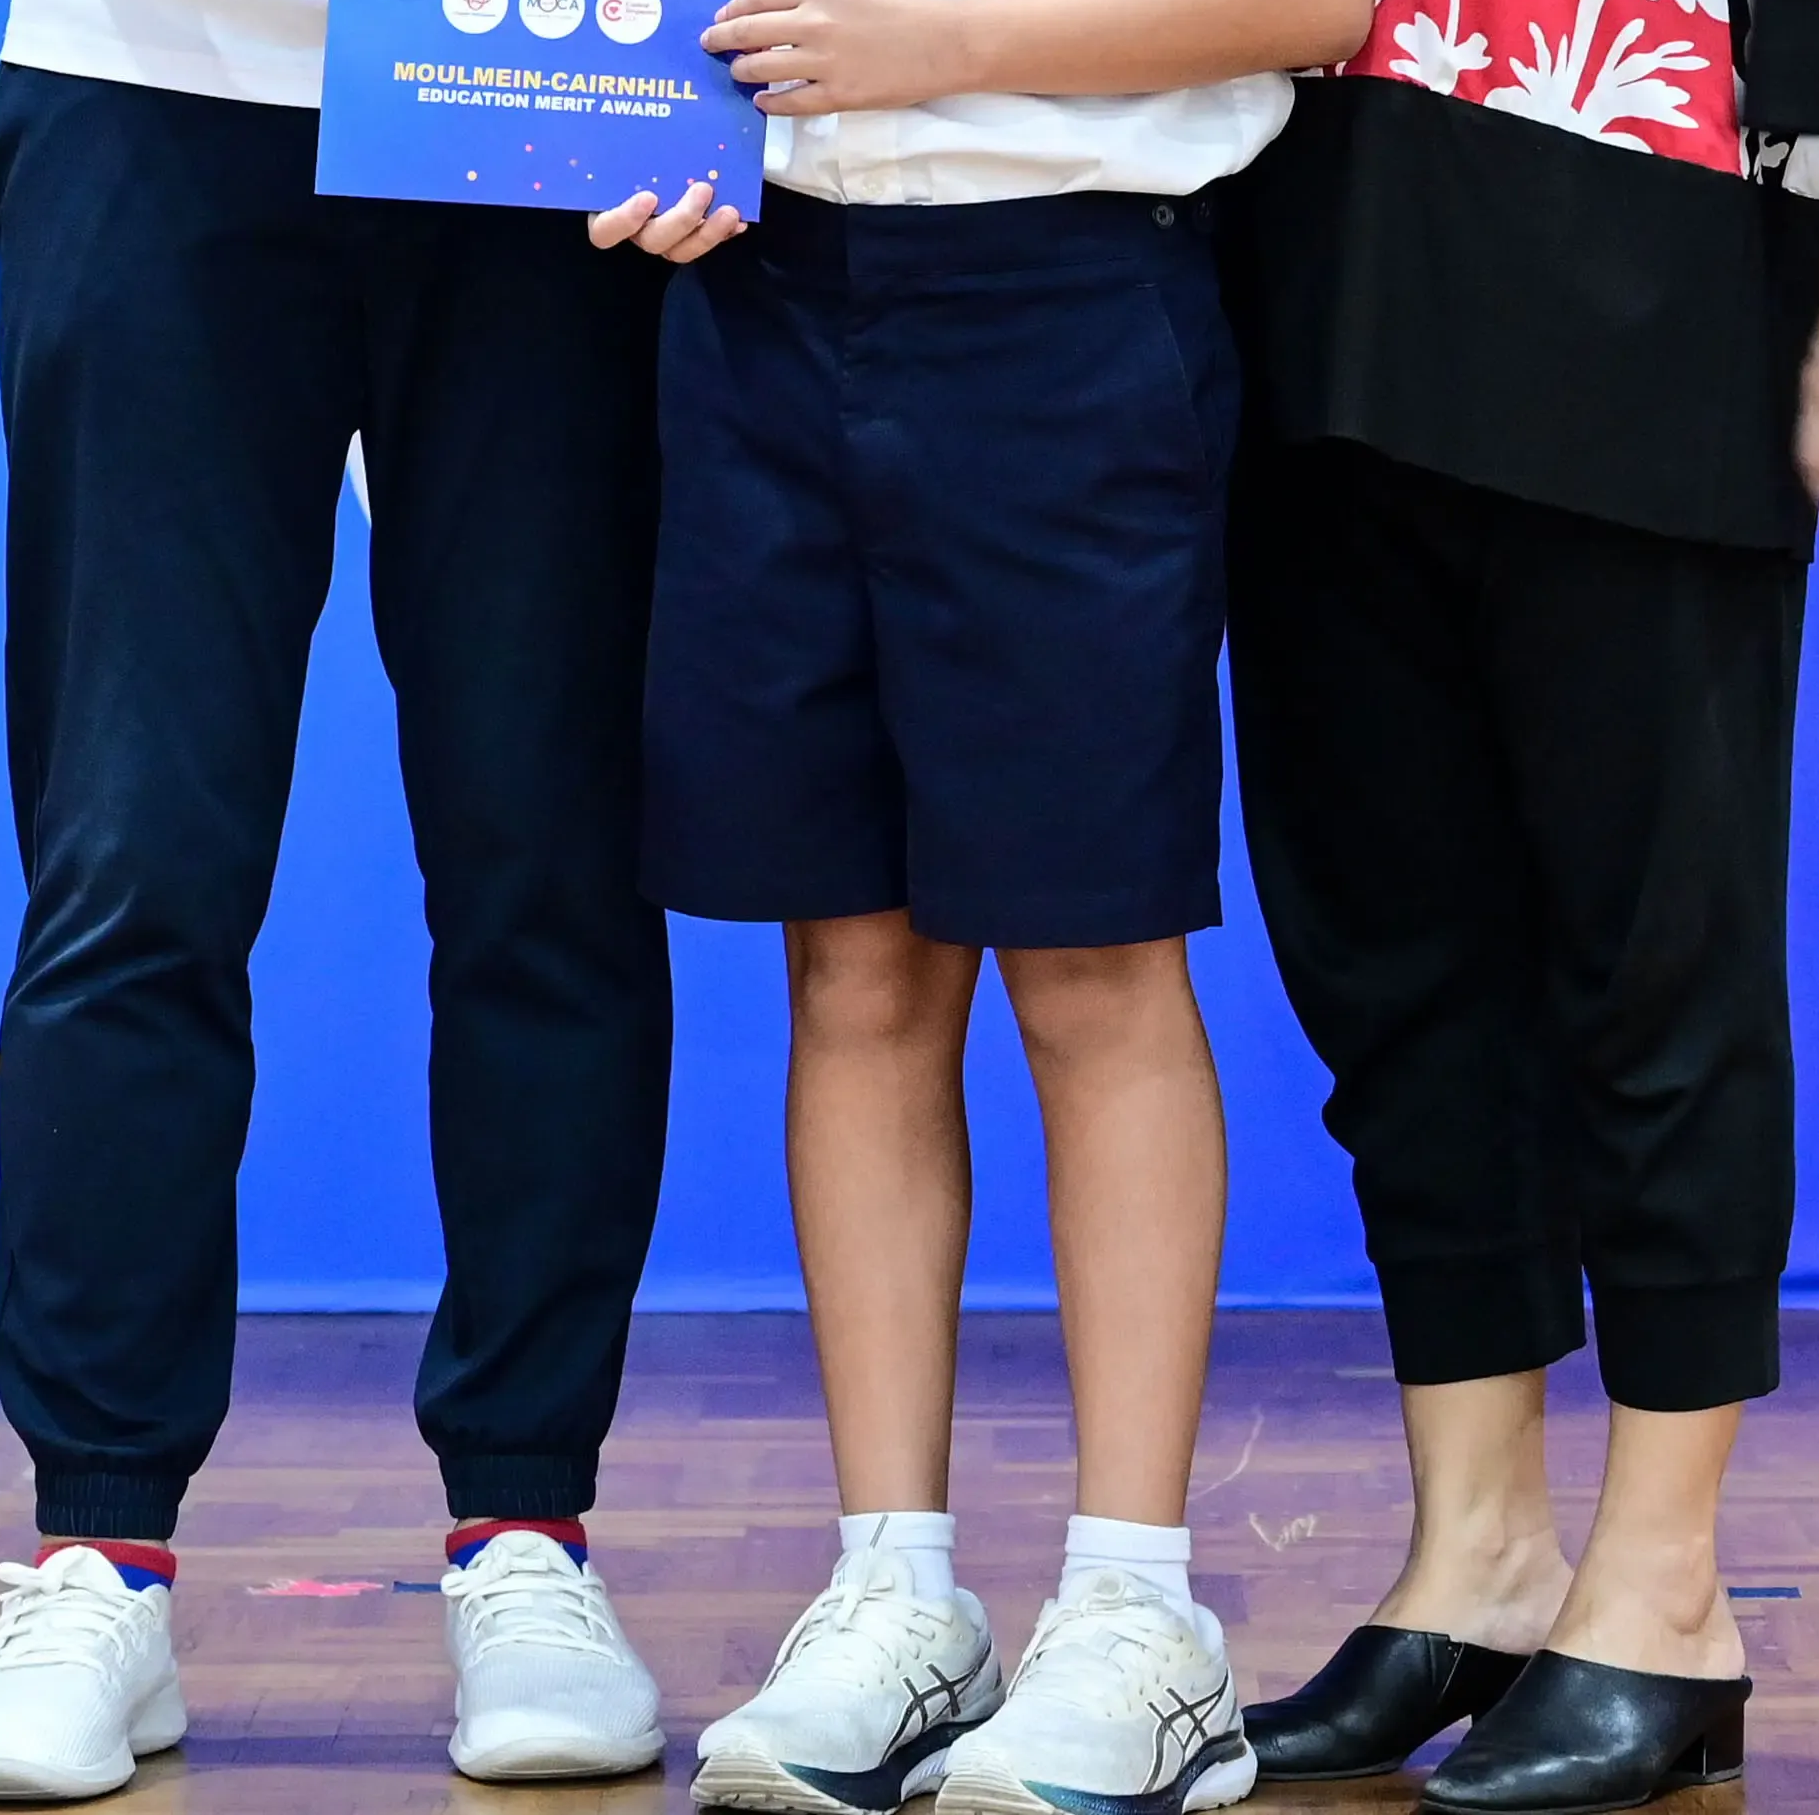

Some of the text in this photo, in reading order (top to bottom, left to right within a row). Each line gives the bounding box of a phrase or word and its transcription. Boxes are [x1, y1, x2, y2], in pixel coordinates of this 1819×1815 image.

[393, 61, 699, 100] MOULMEIN-CAIRNHILL
[417, 87, 671, 118] EDUCATION MERIT AWARD
